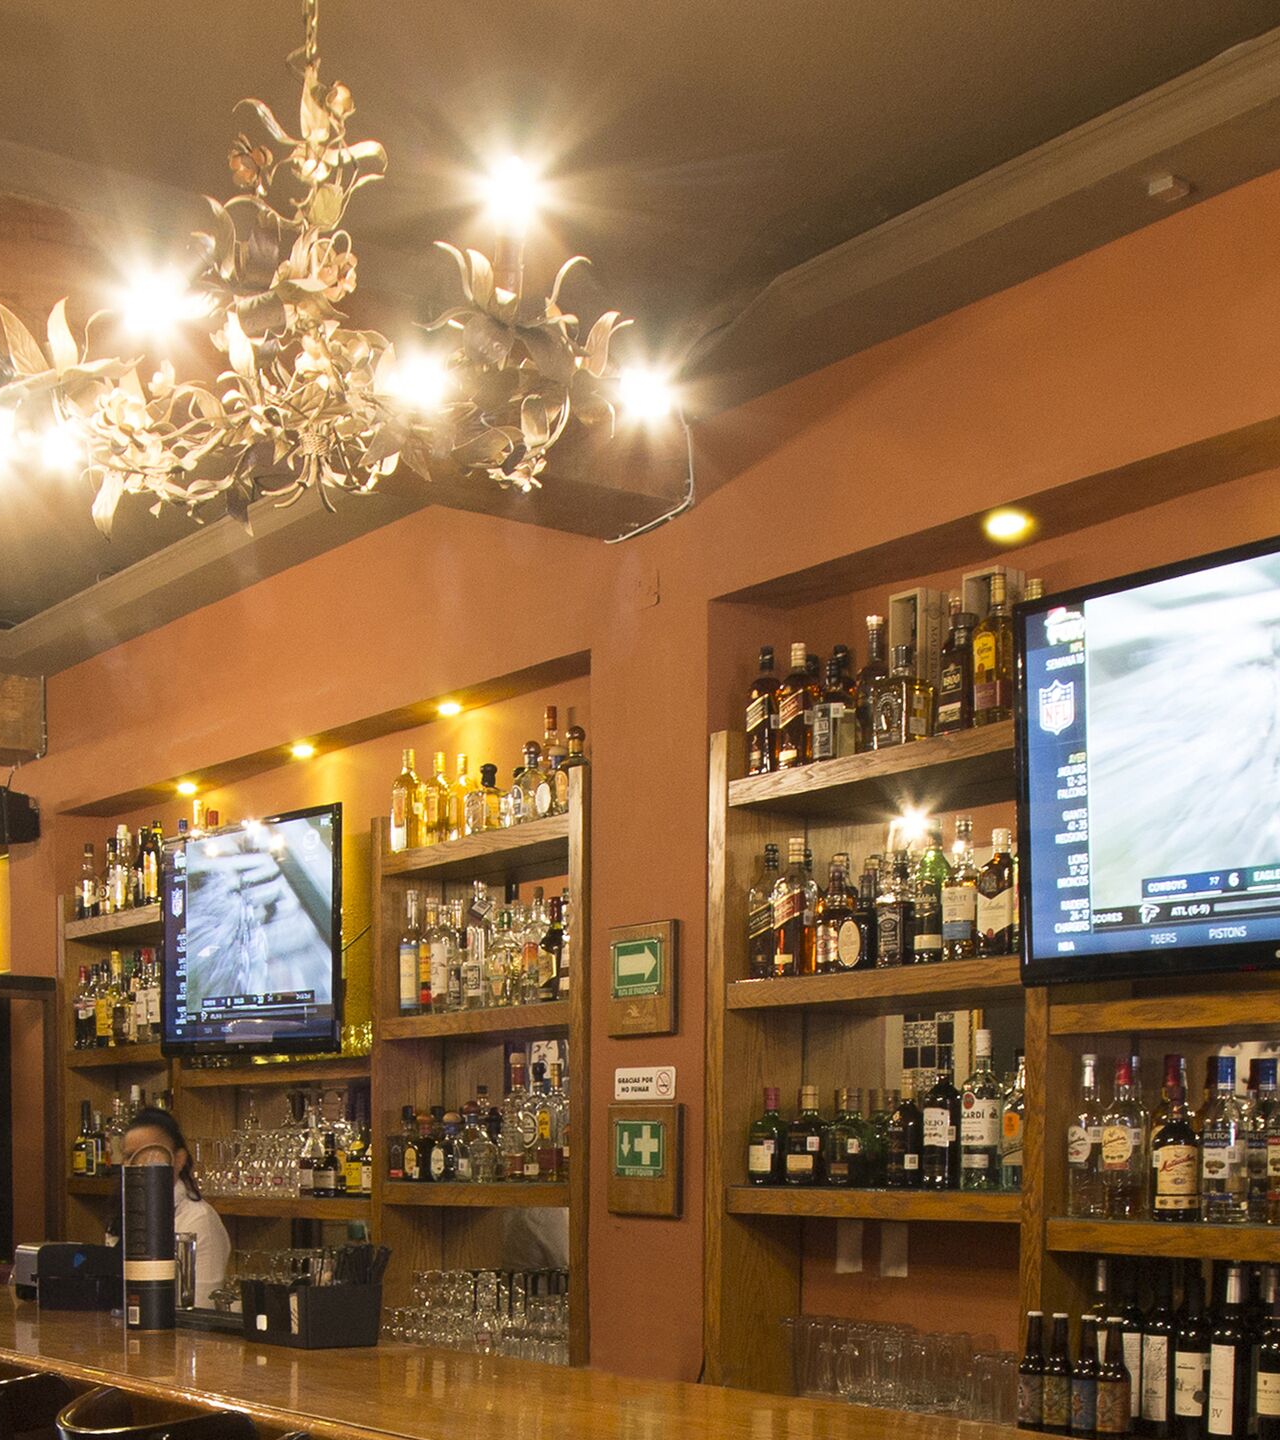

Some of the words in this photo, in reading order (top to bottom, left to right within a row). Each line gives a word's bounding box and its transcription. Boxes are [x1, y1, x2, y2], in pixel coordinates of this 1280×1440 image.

[943, 674, 960, 686] 1800
[1044, 703, 1071, 726] NFL
[1056, 786, 1087, 801] FALCONS
[1061, 808, 1088, 822] GIANTS
[1067, 853, 1089, 866] LIONS
[1147, 878, 1188, 894] COWBOYS
[1228, 872, 1239, 888] 6
[1170, 905, 1188, 917] ATL
[1149, 932, 1178, 945] 76ERS
[1208, 925, 1248, 940] PISTONS
[641, 1076, 653, 1084] POR
[630, 1085, 650, 1093] FUMAR
[962, 1108, 986, 1121] CARDÍ
[1203, 1130, 1230, 1142] PPLETON
